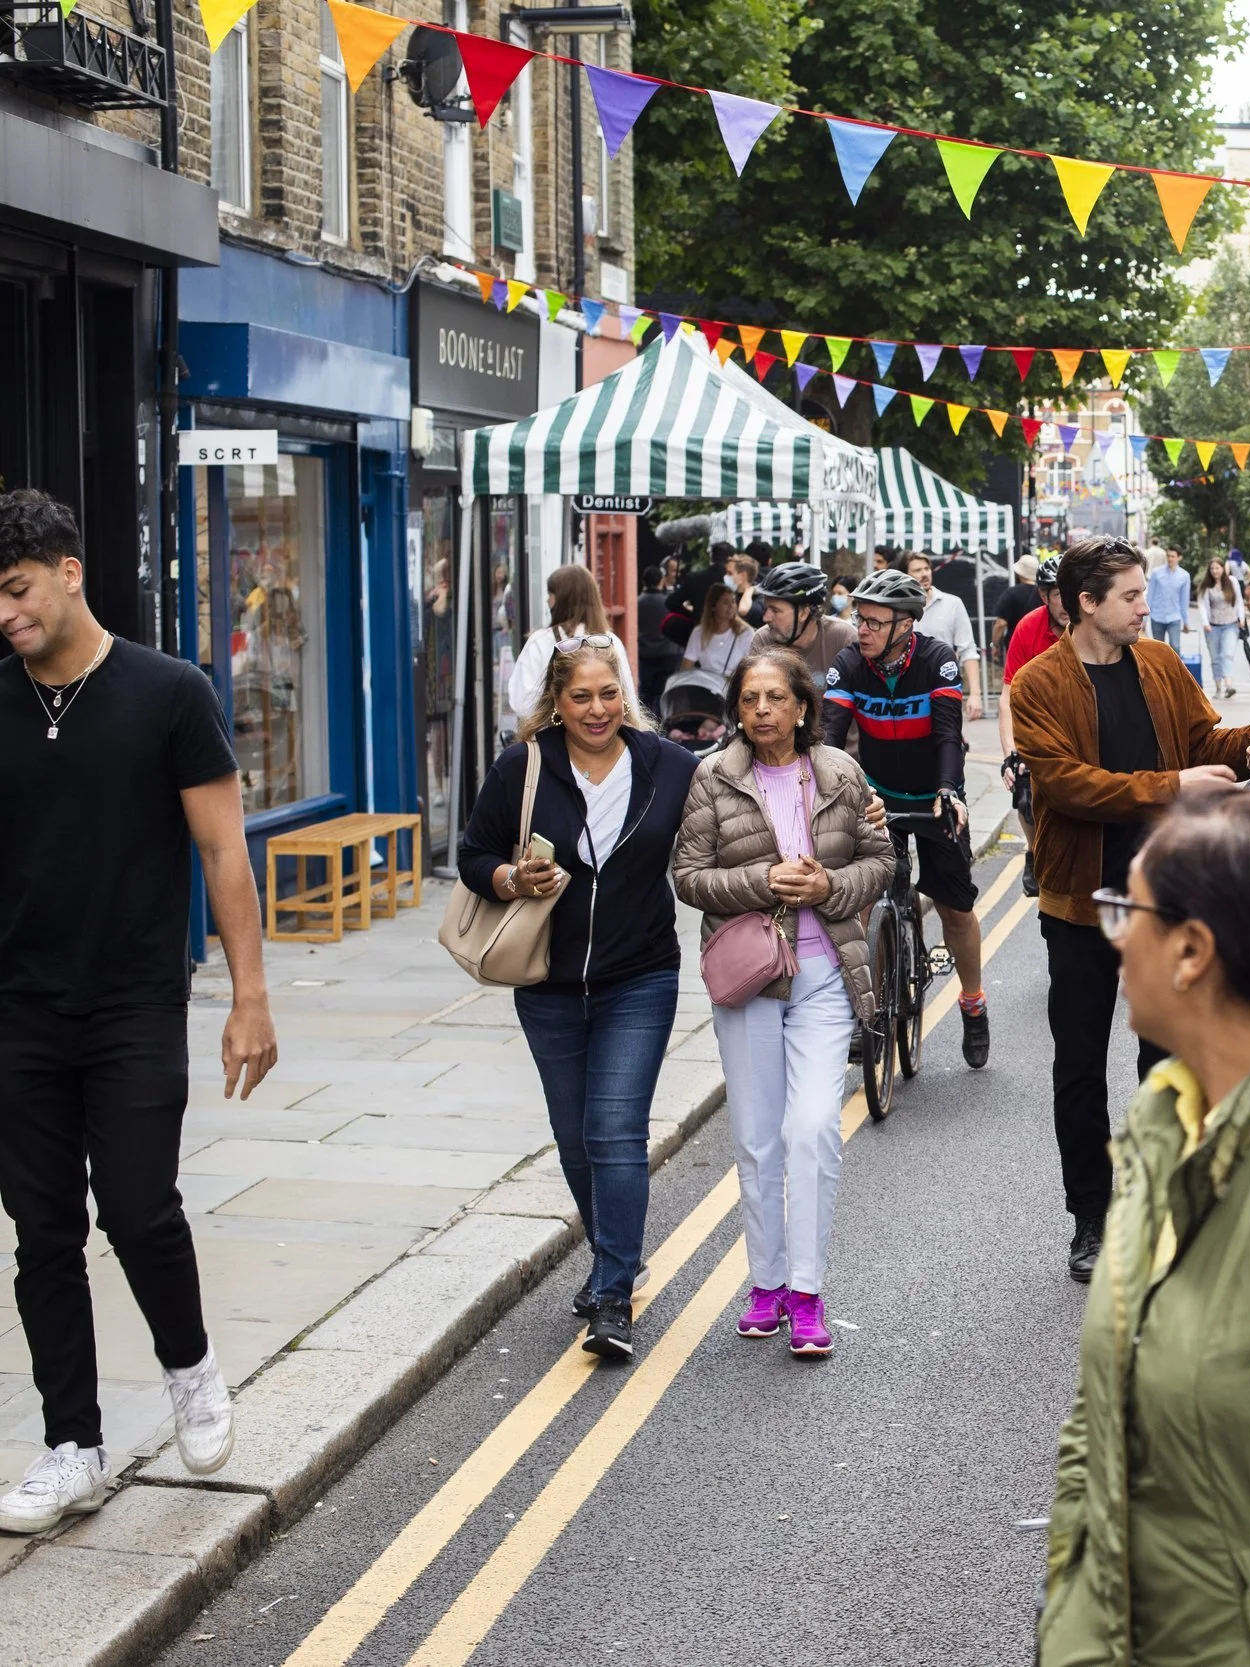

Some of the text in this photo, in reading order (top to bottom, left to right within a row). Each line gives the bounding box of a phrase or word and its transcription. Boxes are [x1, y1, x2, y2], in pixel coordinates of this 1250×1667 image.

[439, 328, 485, 373] BOONE
[495, 343, 524, 382] LAST
[198, 447, 257, 460] SCRT
[582, 495, 641, 510] Dentist
